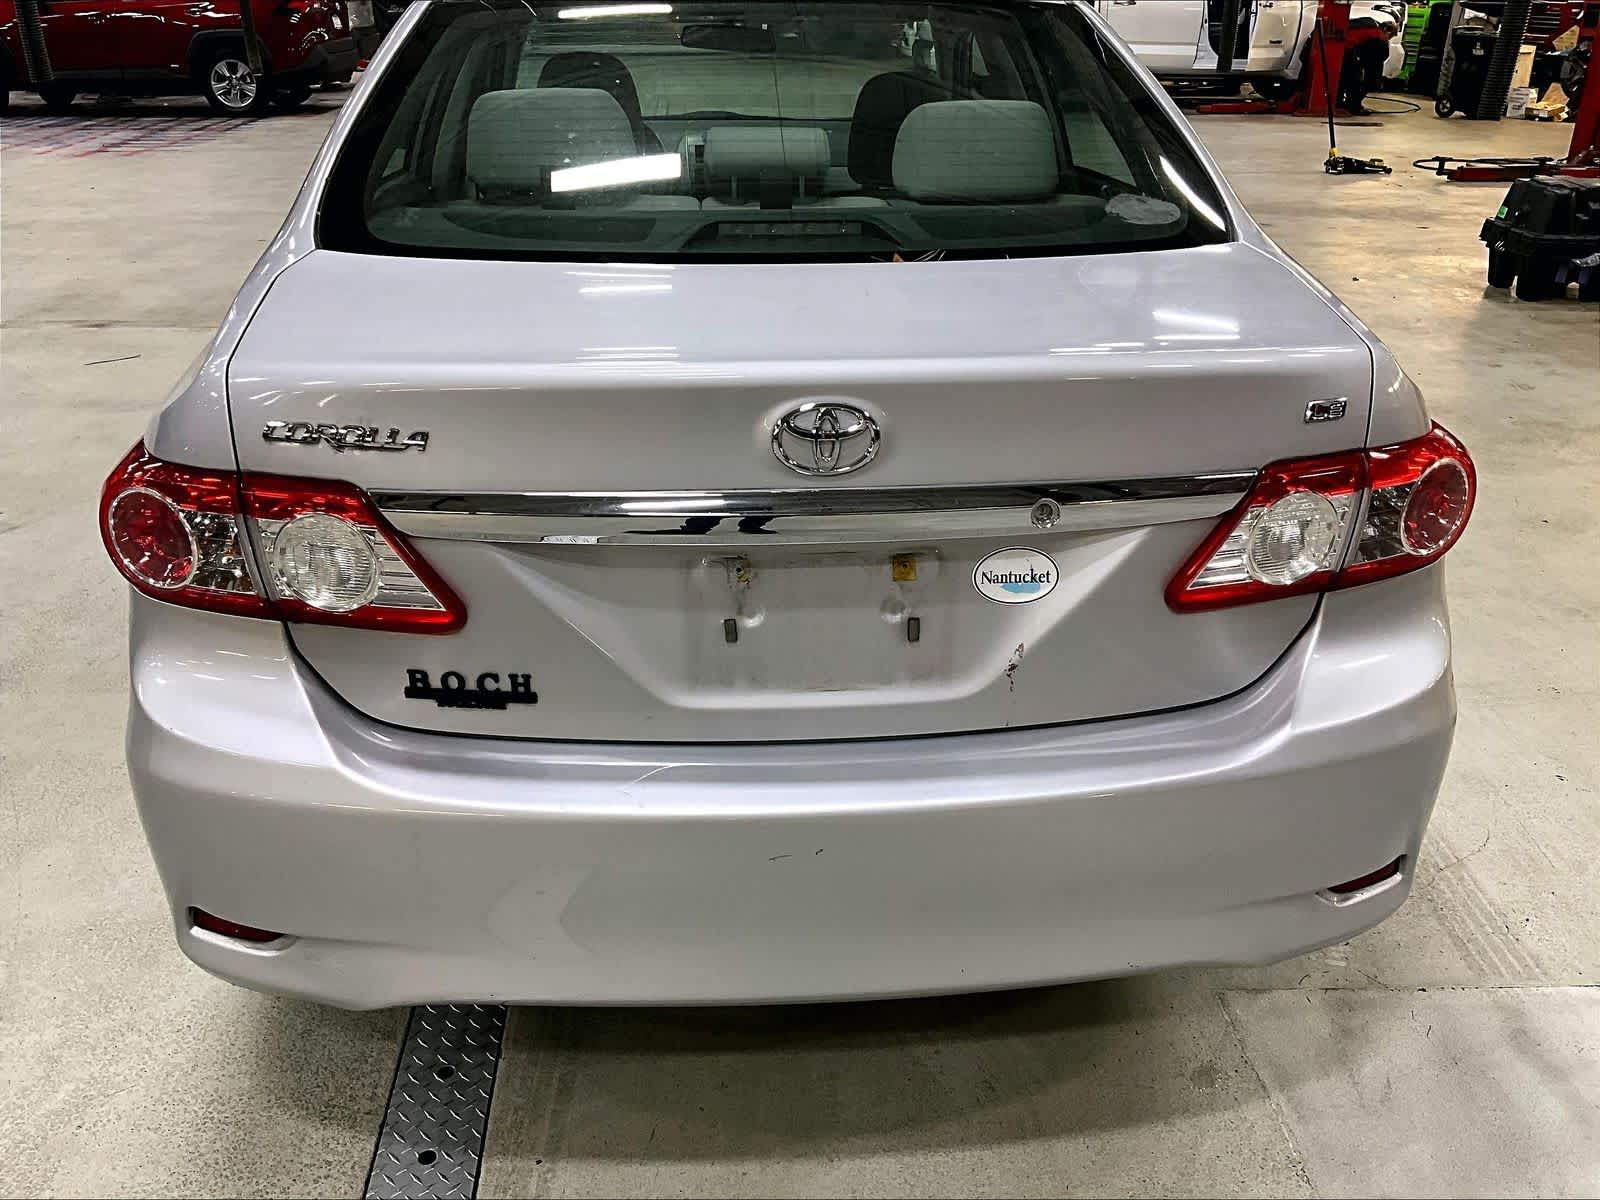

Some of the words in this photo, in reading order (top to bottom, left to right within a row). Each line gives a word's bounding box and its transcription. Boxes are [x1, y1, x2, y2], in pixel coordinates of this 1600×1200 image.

[1304, 398, 1347, 423] LE
[263, 421, 429, 453] COROLLA
[981, 567, 1051, 584] Nantucket
[405, 669, 533, 695] BOCH
